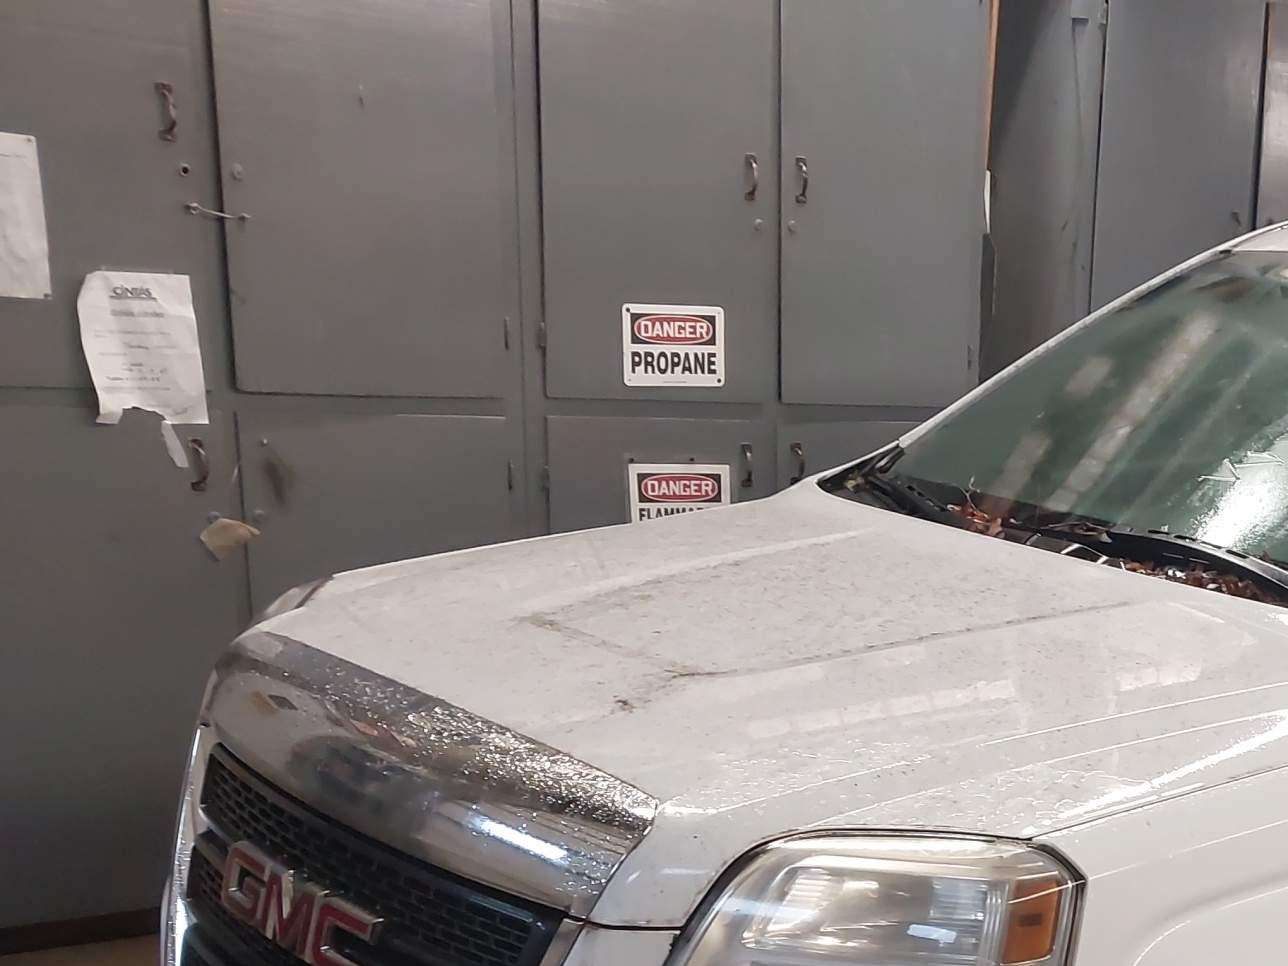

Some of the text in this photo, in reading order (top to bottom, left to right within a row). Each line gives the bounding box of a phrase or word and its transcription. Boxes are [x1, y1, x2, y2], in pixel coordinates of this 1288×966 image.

[640, 320, 708, 338] DANGER
[630, 351, 717, 375] PROPANE
[647, 480, 714, 496] DANGER
